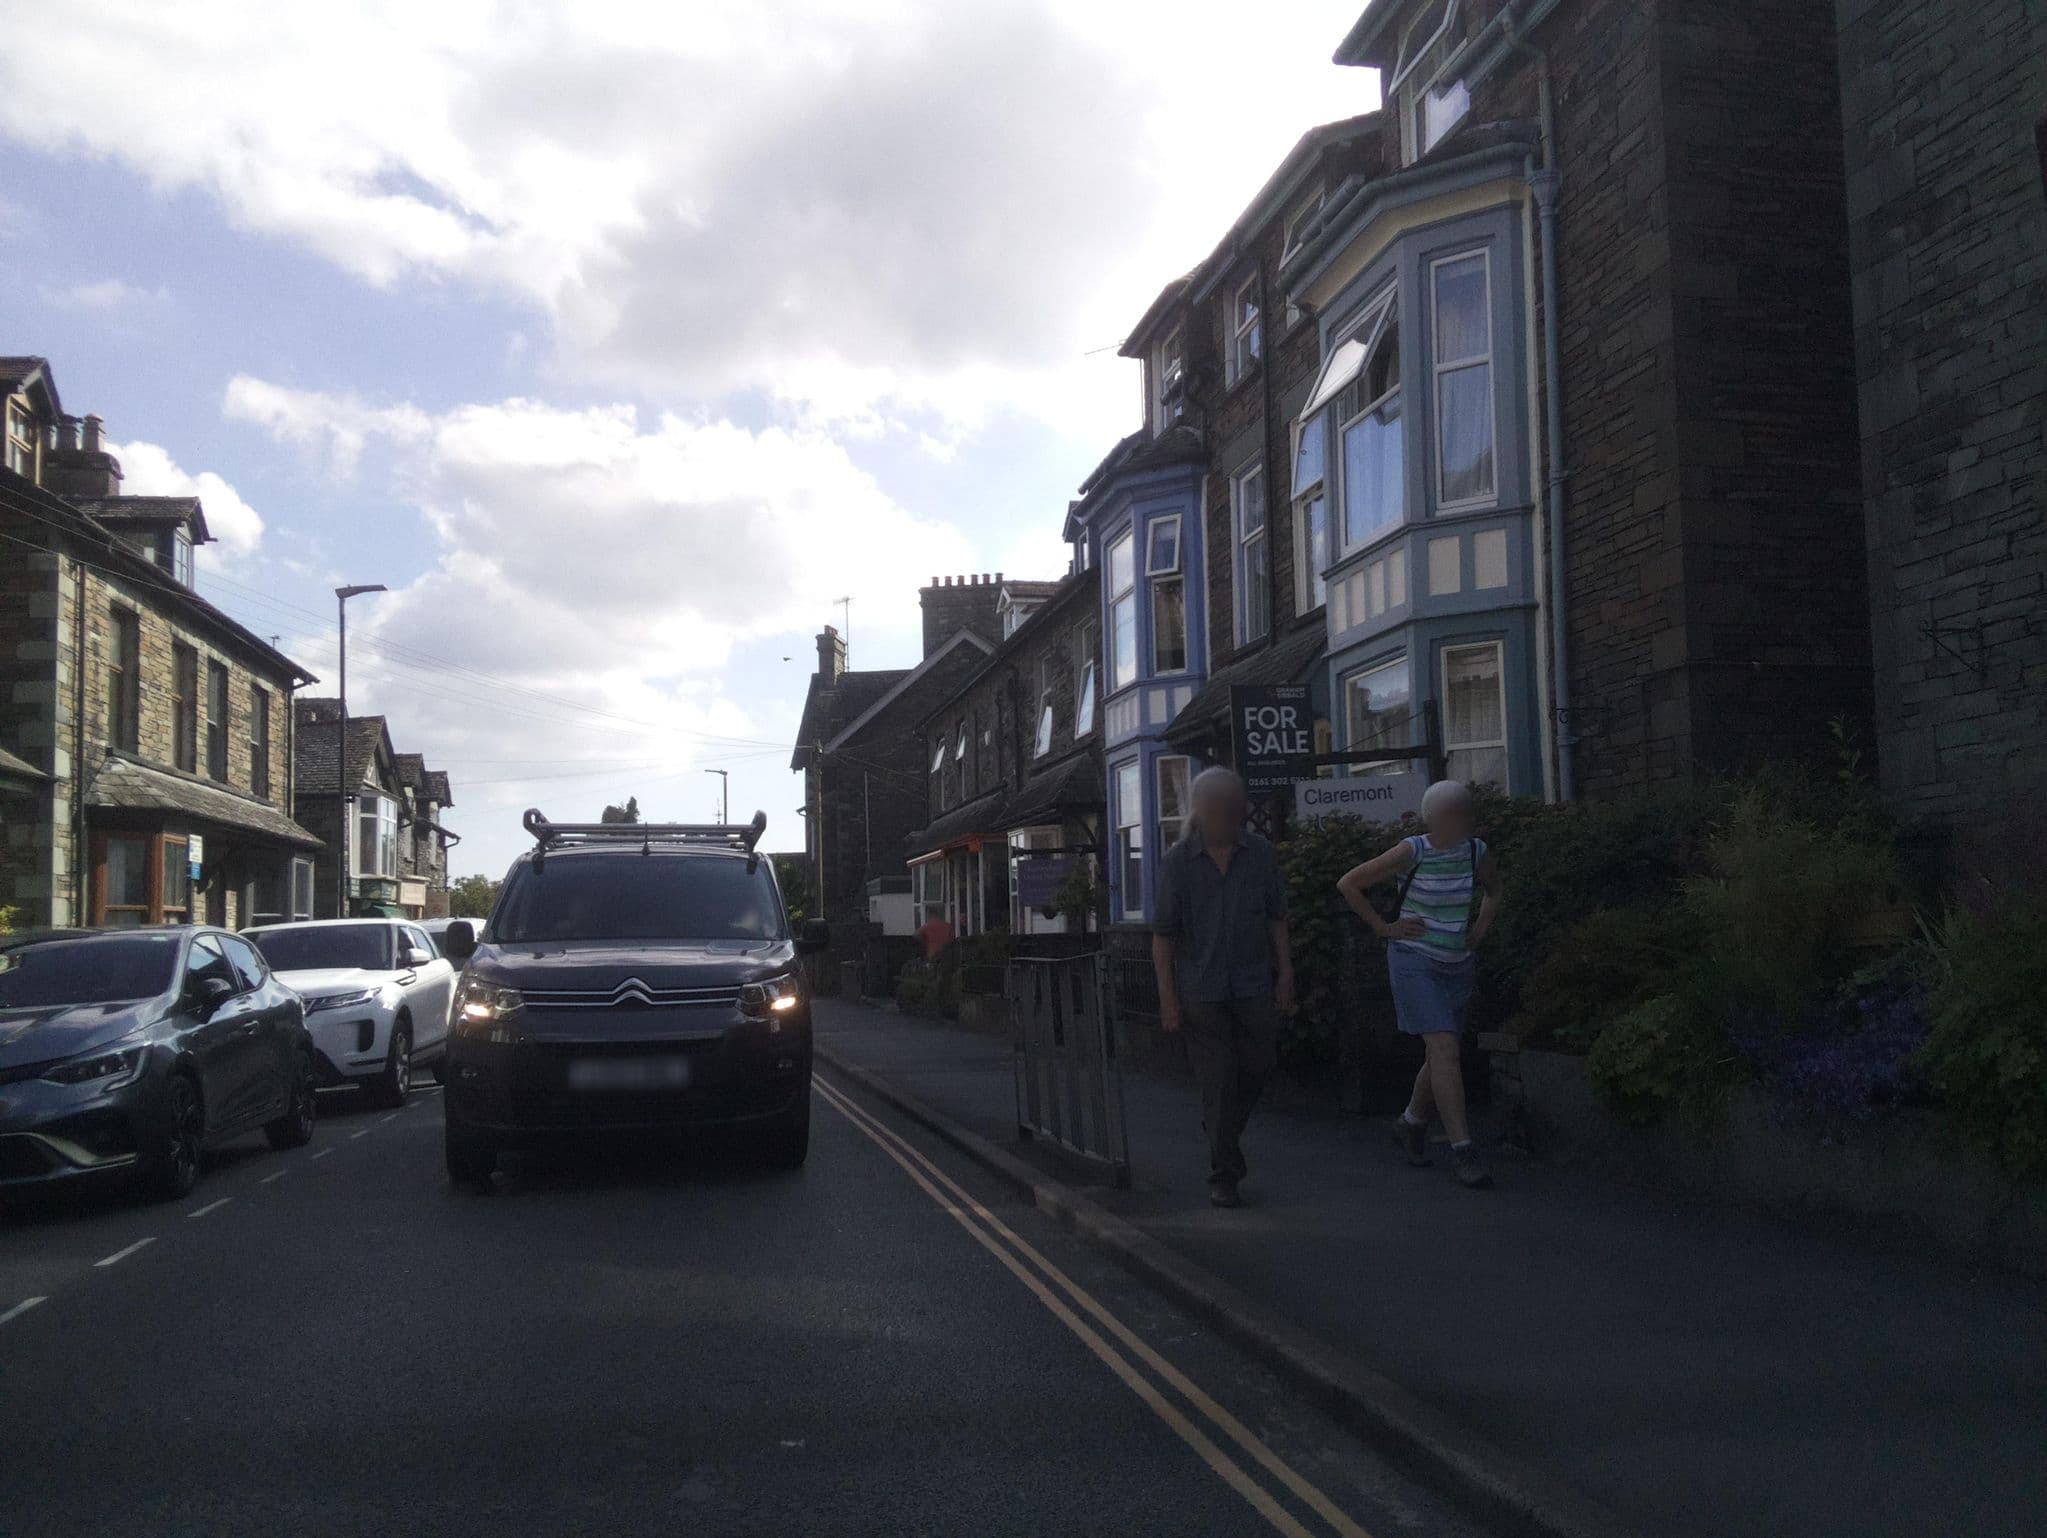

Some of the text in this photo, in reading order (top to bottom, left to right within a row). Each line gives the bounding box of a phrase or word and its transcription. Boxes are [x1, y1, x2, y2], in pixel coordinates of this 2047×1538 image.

[1244, 706, 1297, 729] FOR
[1247, 730, 1309, 755] SALE
[1304, 784, 1393, 805] Claremont
